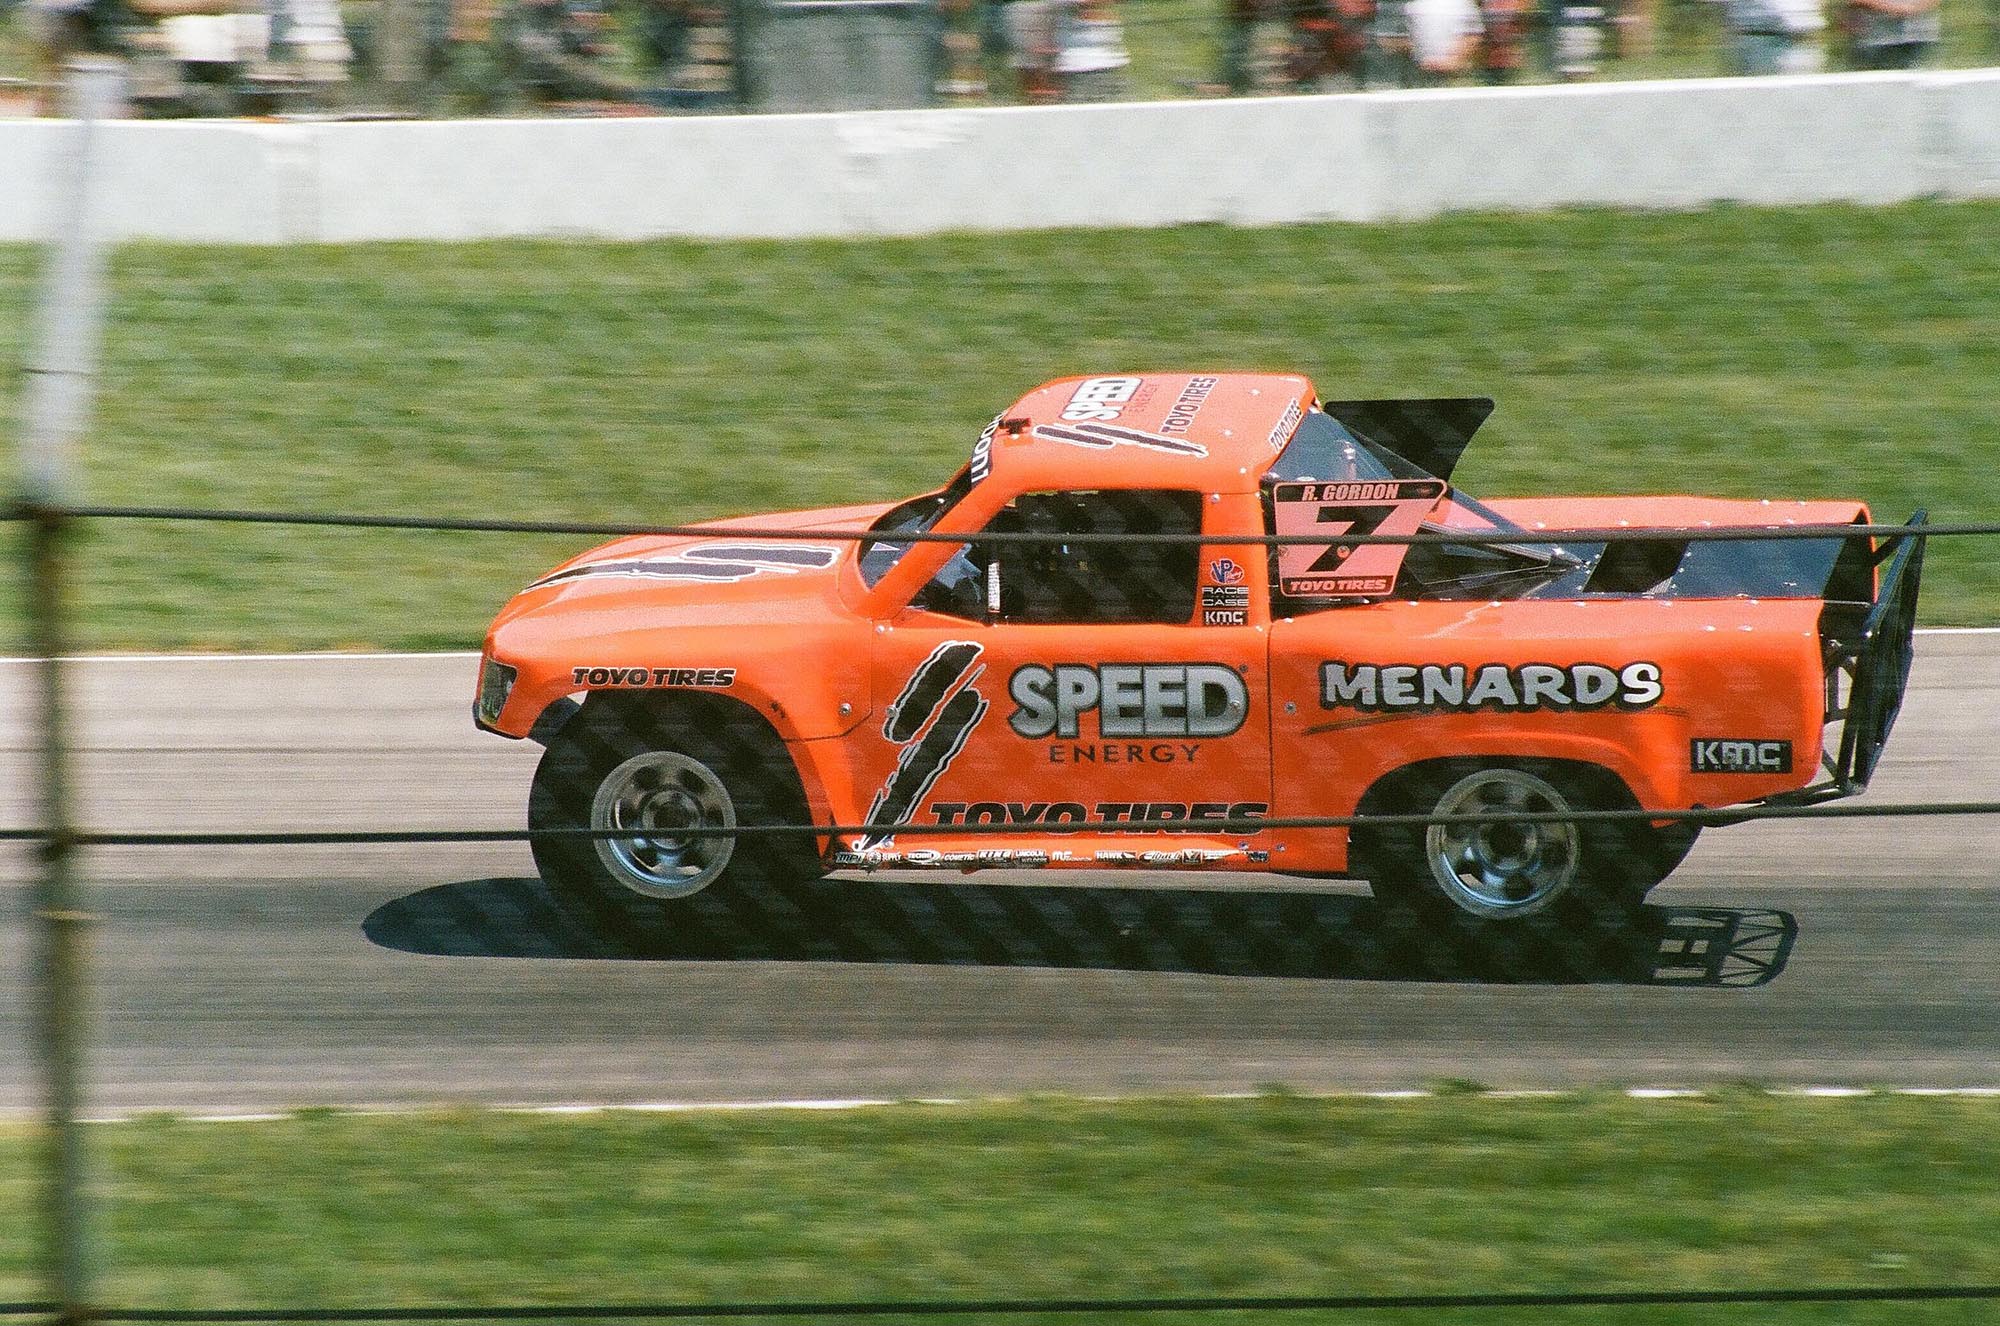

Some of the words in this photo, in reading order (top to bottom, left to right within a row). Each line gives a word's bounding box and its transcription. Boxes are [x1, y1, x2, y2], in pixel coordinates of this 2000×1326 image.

[1058, 377, 1144, 421] SPEED
[1178, 377, 1218, 403] TIRES
[1160, 403, 1199, 434] TOYO
[1302, 485, 1318, 501] R.
[1322, 484, 1400, 500] GORDON
[1305, 504, 1400, 573] 7
[1211, 559, 1233, 583] VP
[1202, 586, 1249, 595] RACE
[1289, 580, 1337, 592] TOYO
[1337, 579, 1387, 591] TIRES
[1202, 598, 1249, 607] CASE
[573, 667, 650, 687] TOYO
[651, 667, 736, 688] TIRES
[1321, 661, 1663, 711] MENARDS
[1008, 662, 1249, 740] SPEED
[1050, 744, 1200, 763] ENERGY
[930, 801, 1088, 835] TOYO
[1094, 801, 1269, 836] TIRES
